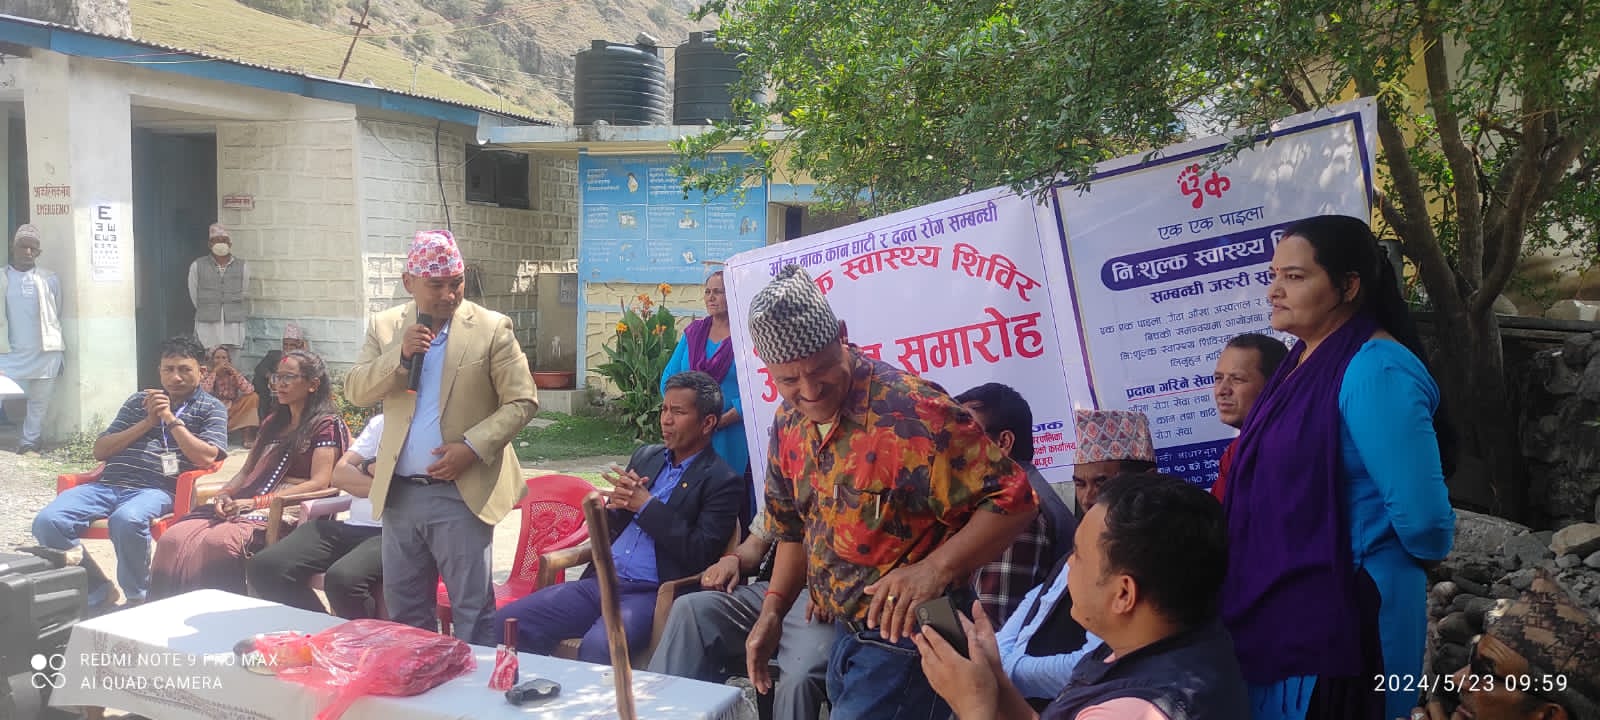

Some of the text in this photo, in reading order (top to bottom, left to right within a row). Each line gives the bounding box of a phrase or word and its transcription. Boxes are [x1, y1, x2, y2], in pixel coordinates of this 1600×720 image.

[880, 233, 889, 248] र
[920, 217, 945, 239] रोग
[948, 200, 998, 233] सम्बन्धी
[1158, 206, 1264, 241] एक एक पाइला
[951, 242, 1042, 302] शिविर
[1150, 280, 1204, 304] सम्बन्धी
[1214, 301, 1251, 315] अस्पताल
[895, 306, 1044, 378] समारोह
[1126, 384, 1155, 400] प्रदान
[1159, 377, 1189, 392] गरिने
